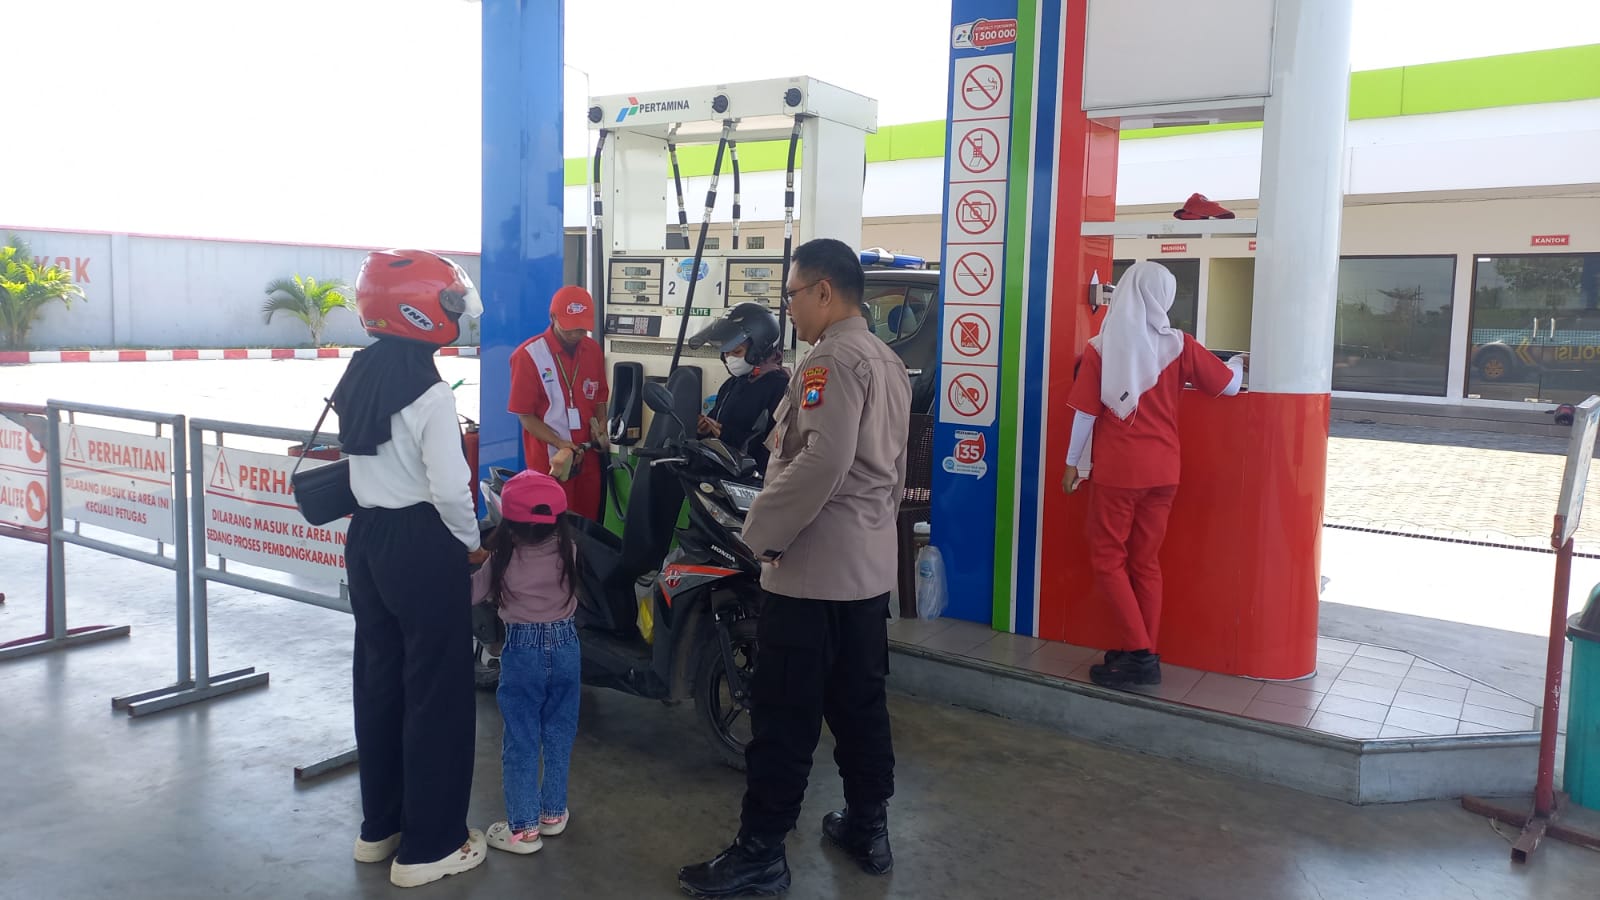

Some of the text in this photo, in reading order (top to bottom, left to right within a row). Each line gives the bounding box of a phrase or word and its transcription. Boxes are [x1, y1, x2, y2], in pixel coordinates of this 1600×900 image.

[639, 100, 690, 113] PERTAMINA
[668, 281, 676, 295] 2
[716, 281, 722, 295] 1
[402, 307, 432, 327] INK
[678, 307, 709, 316] DLITE
[88, 440, 166, 473] PERHATIAN
[956, 444, 980, 460] 135
[0, 485, 24, 509] ALITE
[65, 477, 169, 510] DILARANG MASUK KE AREA INI
[86, 501, 147, 525] KECUALI PETUGAS
[212, 509, 347, 545] DILARANG MASUK KE AREA IN
[207, 528, 232, 546] SEDANG
[234, 535, 261, 552] PROSES
[262, 541, 337, 567] PEMBONGKARAN
[710, 544, 736, 563] HONDA
